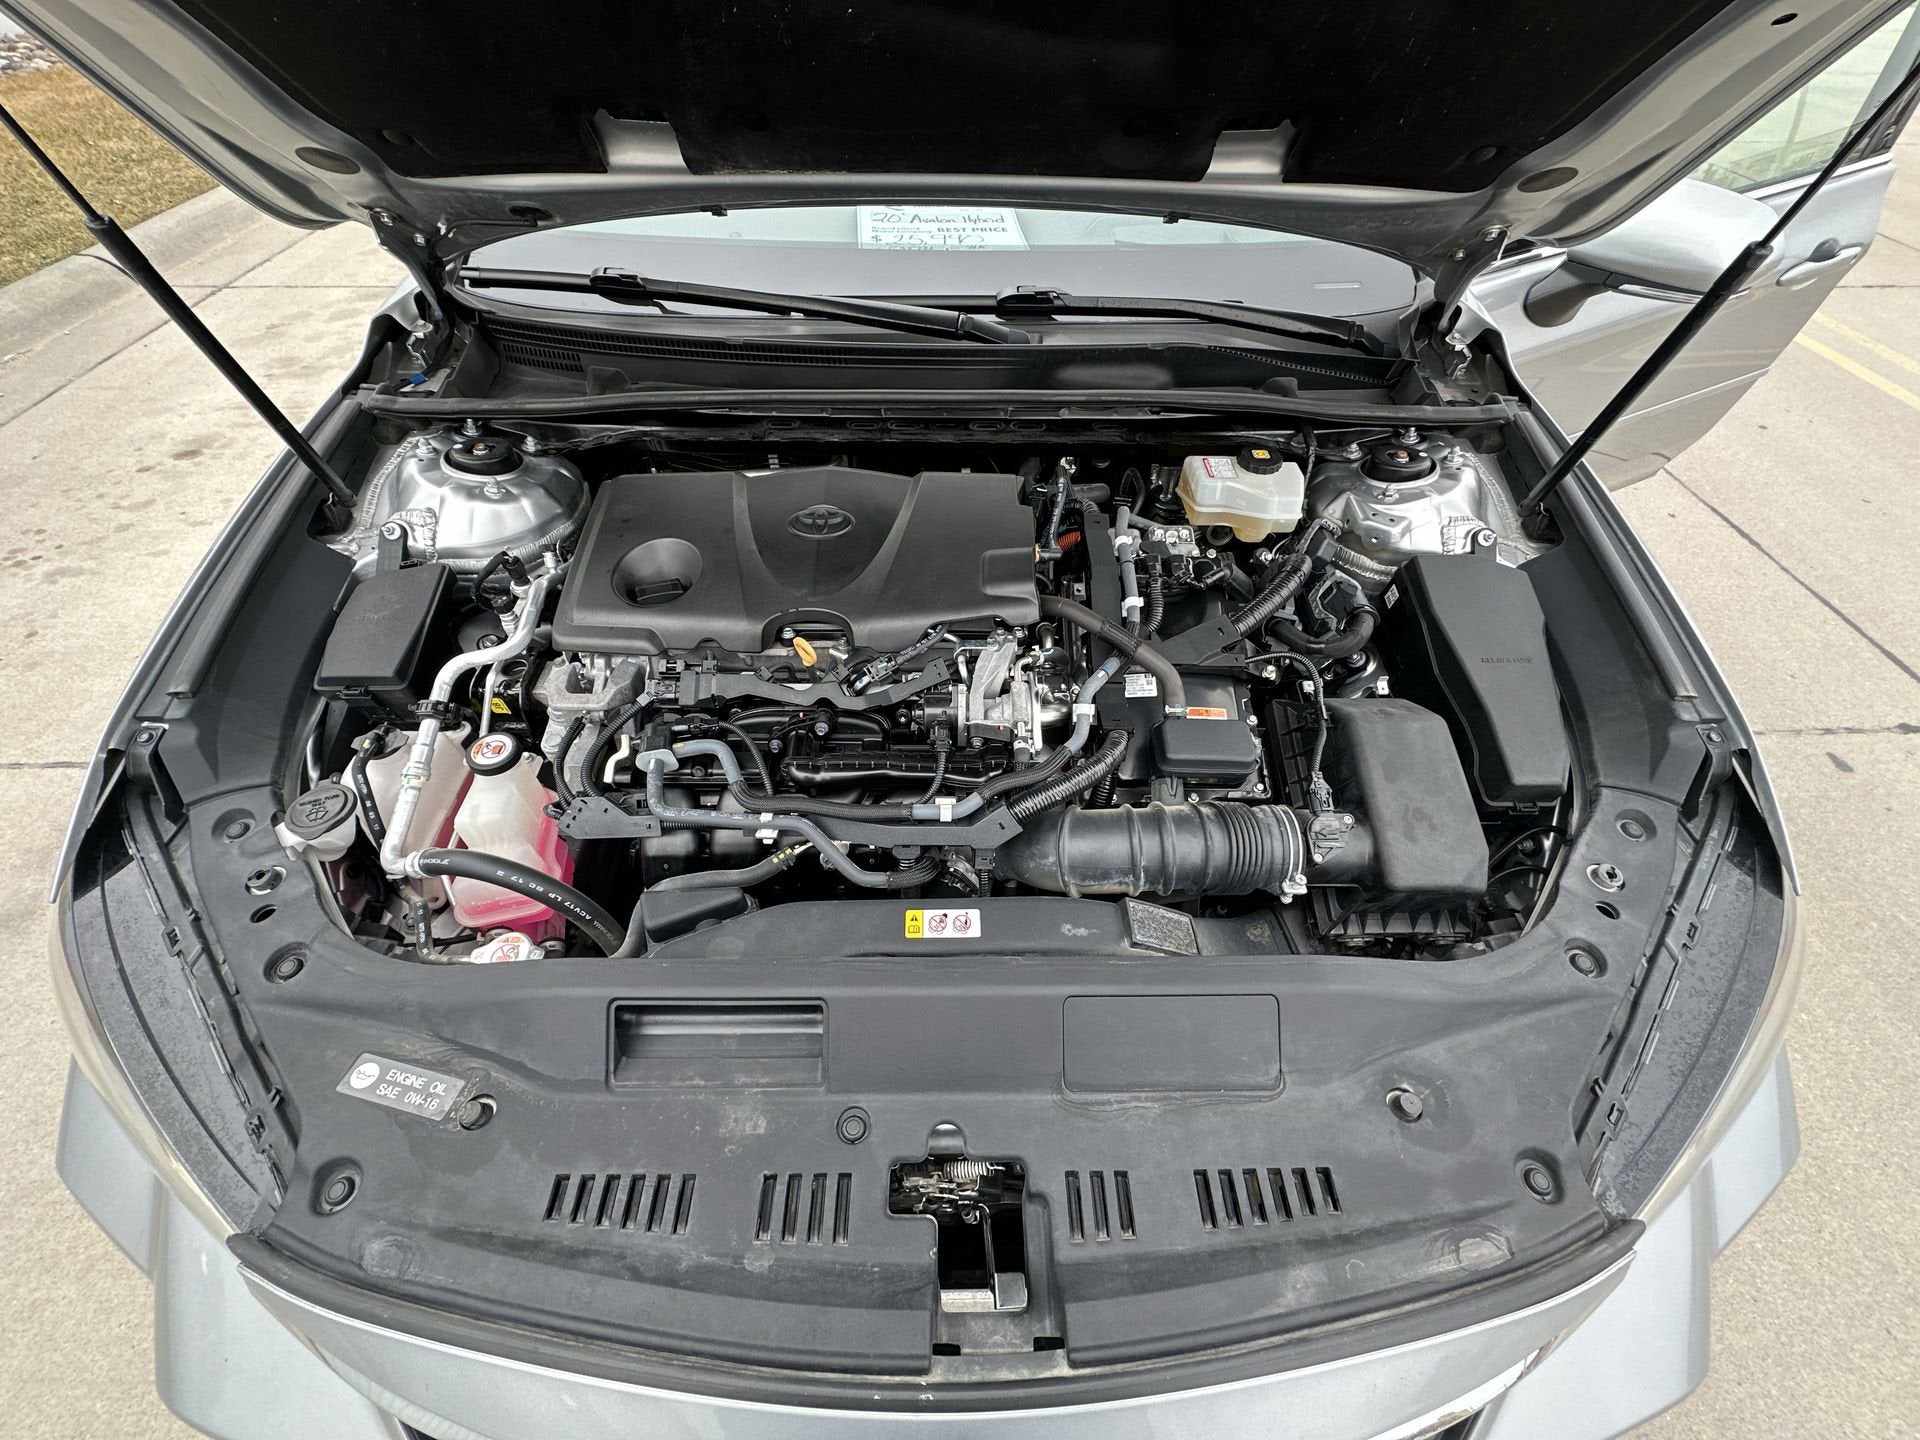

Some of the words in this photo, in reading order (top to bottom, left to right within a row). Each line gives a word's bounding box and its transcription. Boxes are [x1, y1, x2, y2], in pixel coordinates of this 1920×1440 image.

[910, 214, 956, 223] Avalon
[962, 214, 1005, 225] Hybrid
[548, 892, 562, 902] LP
[564, 901, 591, 920] ACV17
[385, 1068, 428, 1090] ENGINE
[429, 1081, 447, 1096] OIL
[376, 1083, 402, 1099] SAE
[404, 1091, 440, 1110] 0W-16
